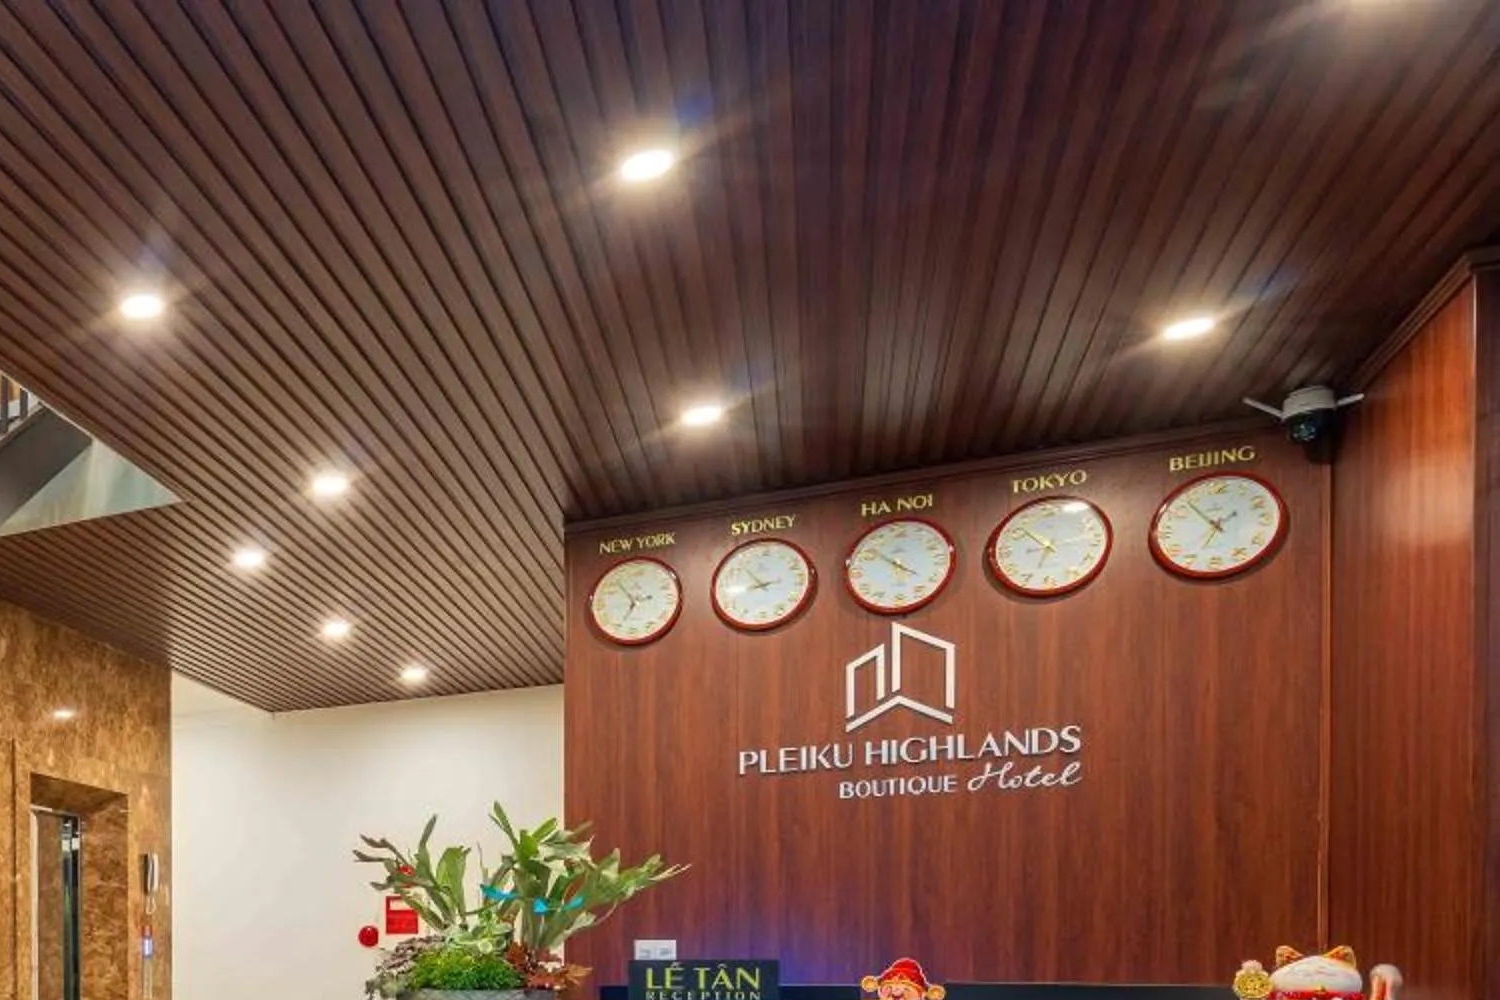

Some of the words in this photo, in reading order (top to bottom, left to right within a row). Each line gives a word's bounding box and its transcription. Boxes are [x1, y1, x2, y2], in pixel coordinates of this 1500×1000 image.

[1169, 446, 1256, 472] BEIJING
[1012, 469, 1088, 493] TOKYO
[861, 501, 891, 516] HA
[897, 494, 933, 511] NOI
[731, 514, 796, 536] SYDNEY
[599, 538, 632, 554] NEW
[634, 532, 676, 550] YORK
[739, 743, 854, 775] PLEIKU
[865, 725, 1082, 766] HIGHLANDS
[839, 775, 957, 799] BOUTIQUE
[966, 761, 1082, 791] Hotel
[693, 963, 760, 990] TÂN
[646, 991, 761, 1000] RECEPTION
